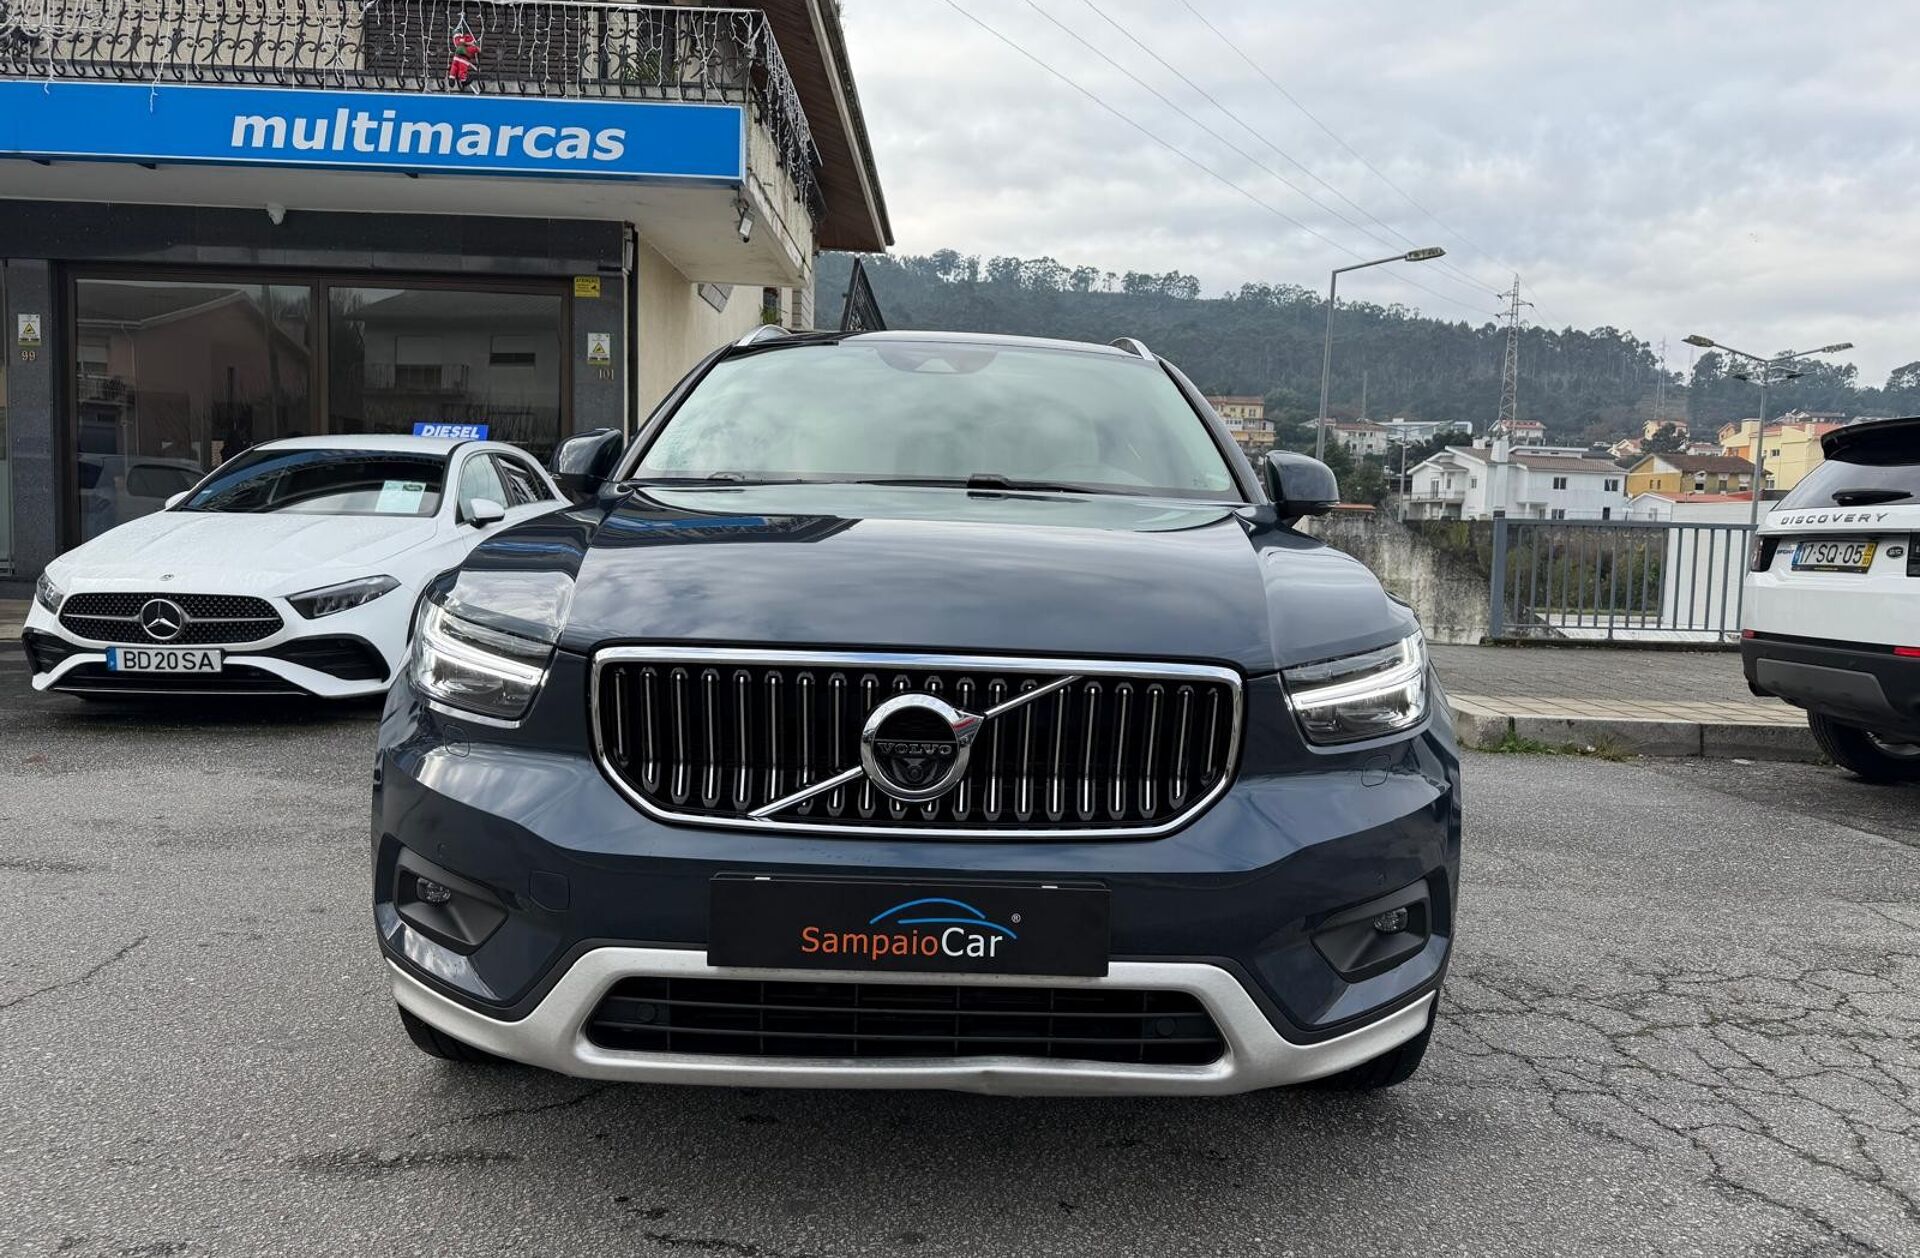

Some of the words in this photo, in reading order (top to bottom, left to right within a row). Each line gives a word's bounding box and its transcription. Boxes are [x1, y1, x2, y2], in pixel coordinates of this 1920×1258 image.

[231, 107, 626, 161] multimarcas
[421, 425, 480, 438] DIESEL
[1780, 512, 1889, 525] DISCOVERY
[876, 742, 952, 755] VOLVO
[801, 926, 1003, 961] SampaioCar
